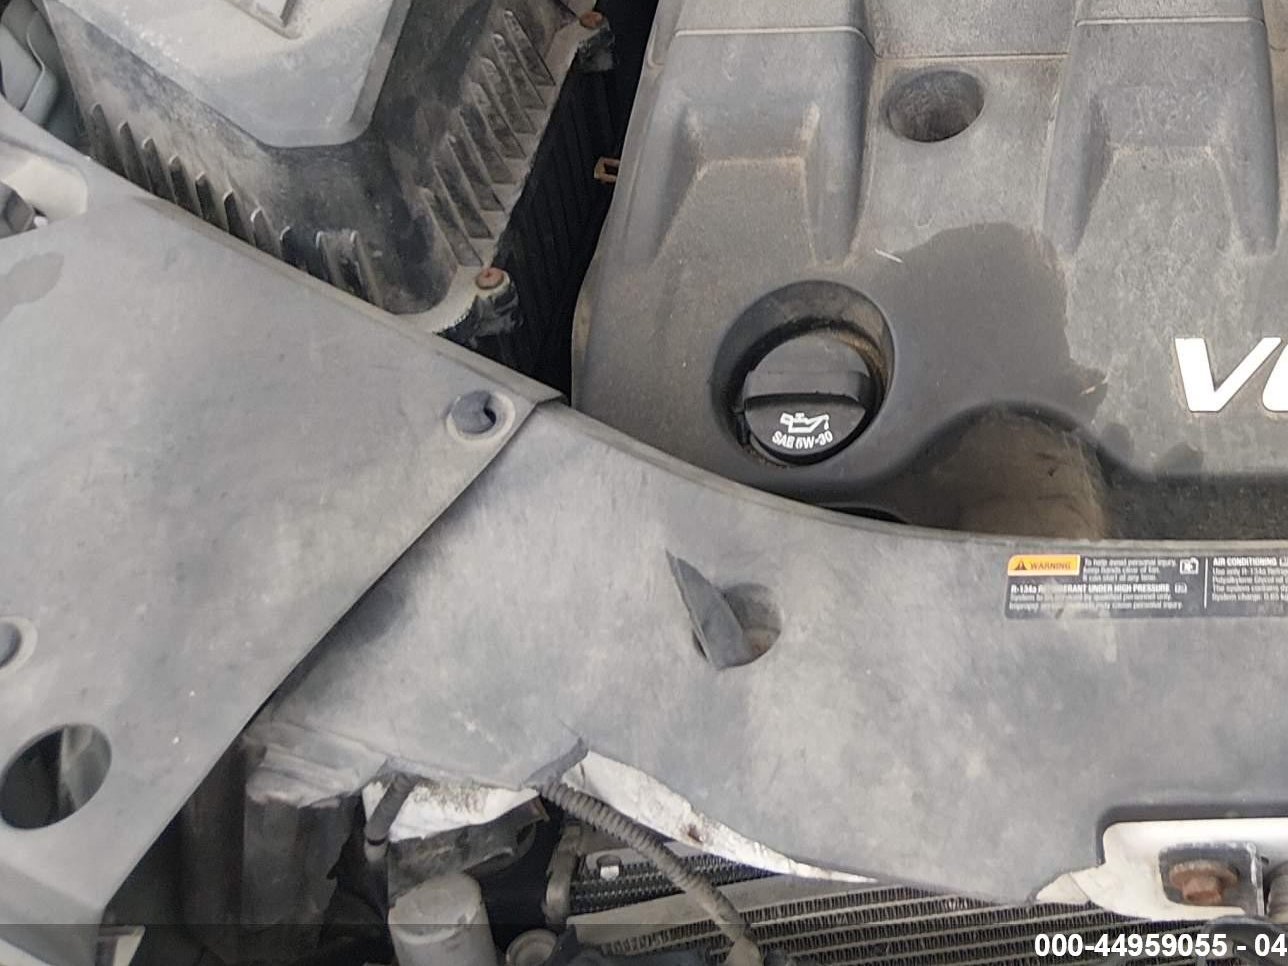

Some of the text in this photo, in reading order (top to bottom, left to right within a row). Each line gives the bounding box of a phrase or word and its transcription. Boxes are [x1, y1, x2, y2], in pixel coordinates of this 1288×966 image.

[771, 430, 795, 449] SAE
[1029, 561, 1072, 571] WARNING
[1213, 557, 1278, 567] AIR CONDITIONING
